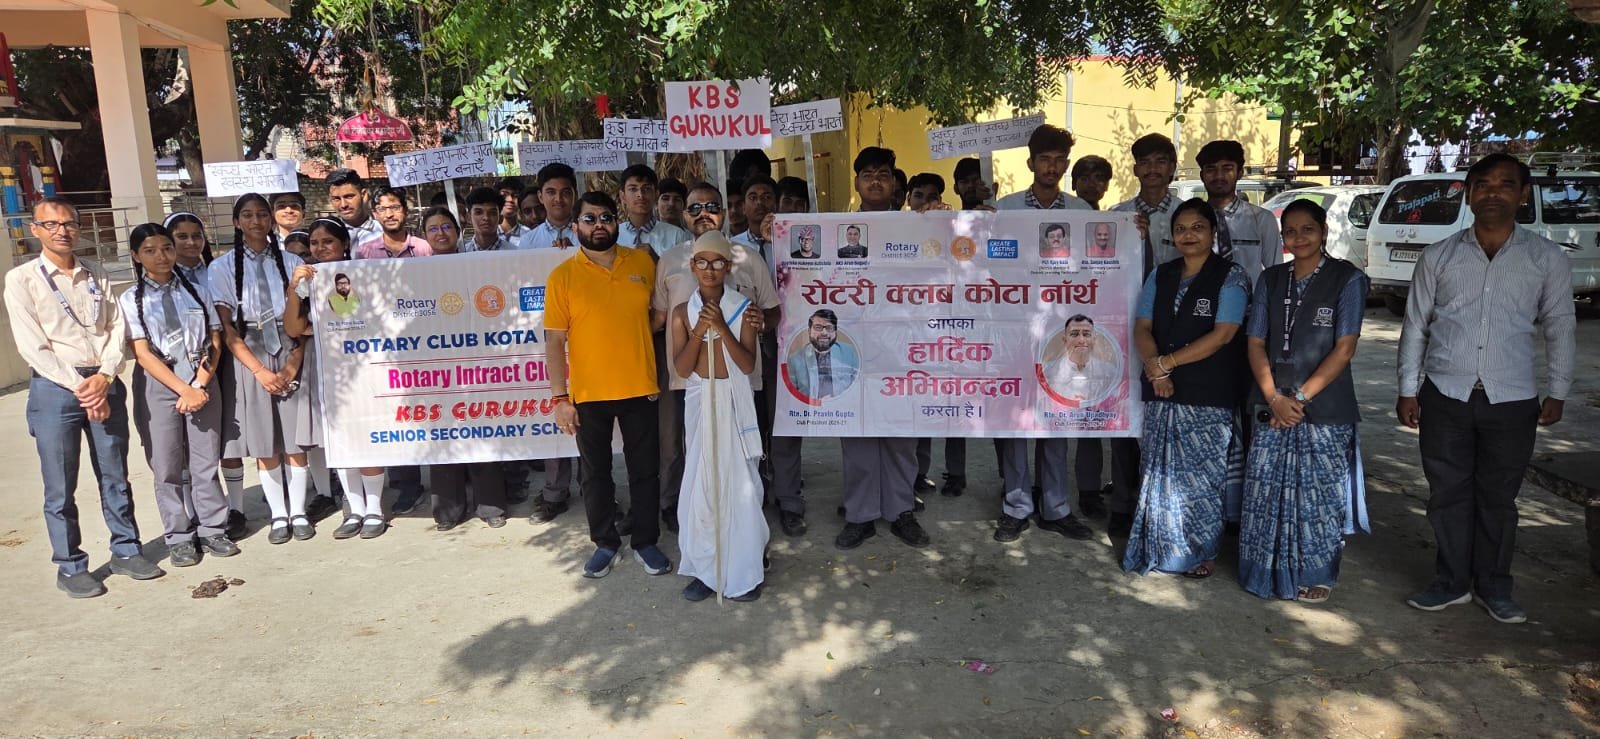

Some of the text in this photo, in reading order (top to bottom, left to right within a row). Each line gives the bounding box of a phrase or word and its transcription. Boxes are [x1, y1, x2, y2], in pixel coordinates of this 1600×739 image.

[688, 84, 740, 109] KBS
[793, 109, 818, 121] भारत
[669, 114, 772, 139] GURUKUL
[472, 143, 493, 158] भारत
[605, 137, 634, 151] स्वच्छ
[636, 137, 658, 151] भारत
[1397, 188, 1441, 214] Prajapati
[885, 242, 919, 253] Rotary
[522, 288, 546, 296] CREAT
[524, 295, 546, 303] LASTI
[801, 278, 1099, 306] रोटरी क्लब कोटा नॉर्थ
[397, 298, 437, 310] Rotary
[526, 301, 546, 310] IMPA
[392, 311, 418, 319] District
[927, 317, 975, 330] आपका
[343, 336, 421, 354] ROTARY
[427, 332, 479, 349] CLUB
[484, 329, 538, 346] KOTA
[907, 335, 994, 364] हार्दिक
[388, 366, 451, 389] Rotary
[456, 363, 521, 386] Intract
[879, 369, 1023, 398] अभिनन्दन
[395, 398, 555, 423] KBS GURUKU
[835, 410, 856, 418] Gupta
[921, 404, 959, 418] करता
[370, 422, 564, 444] SENIOR SECONDARY SCH
